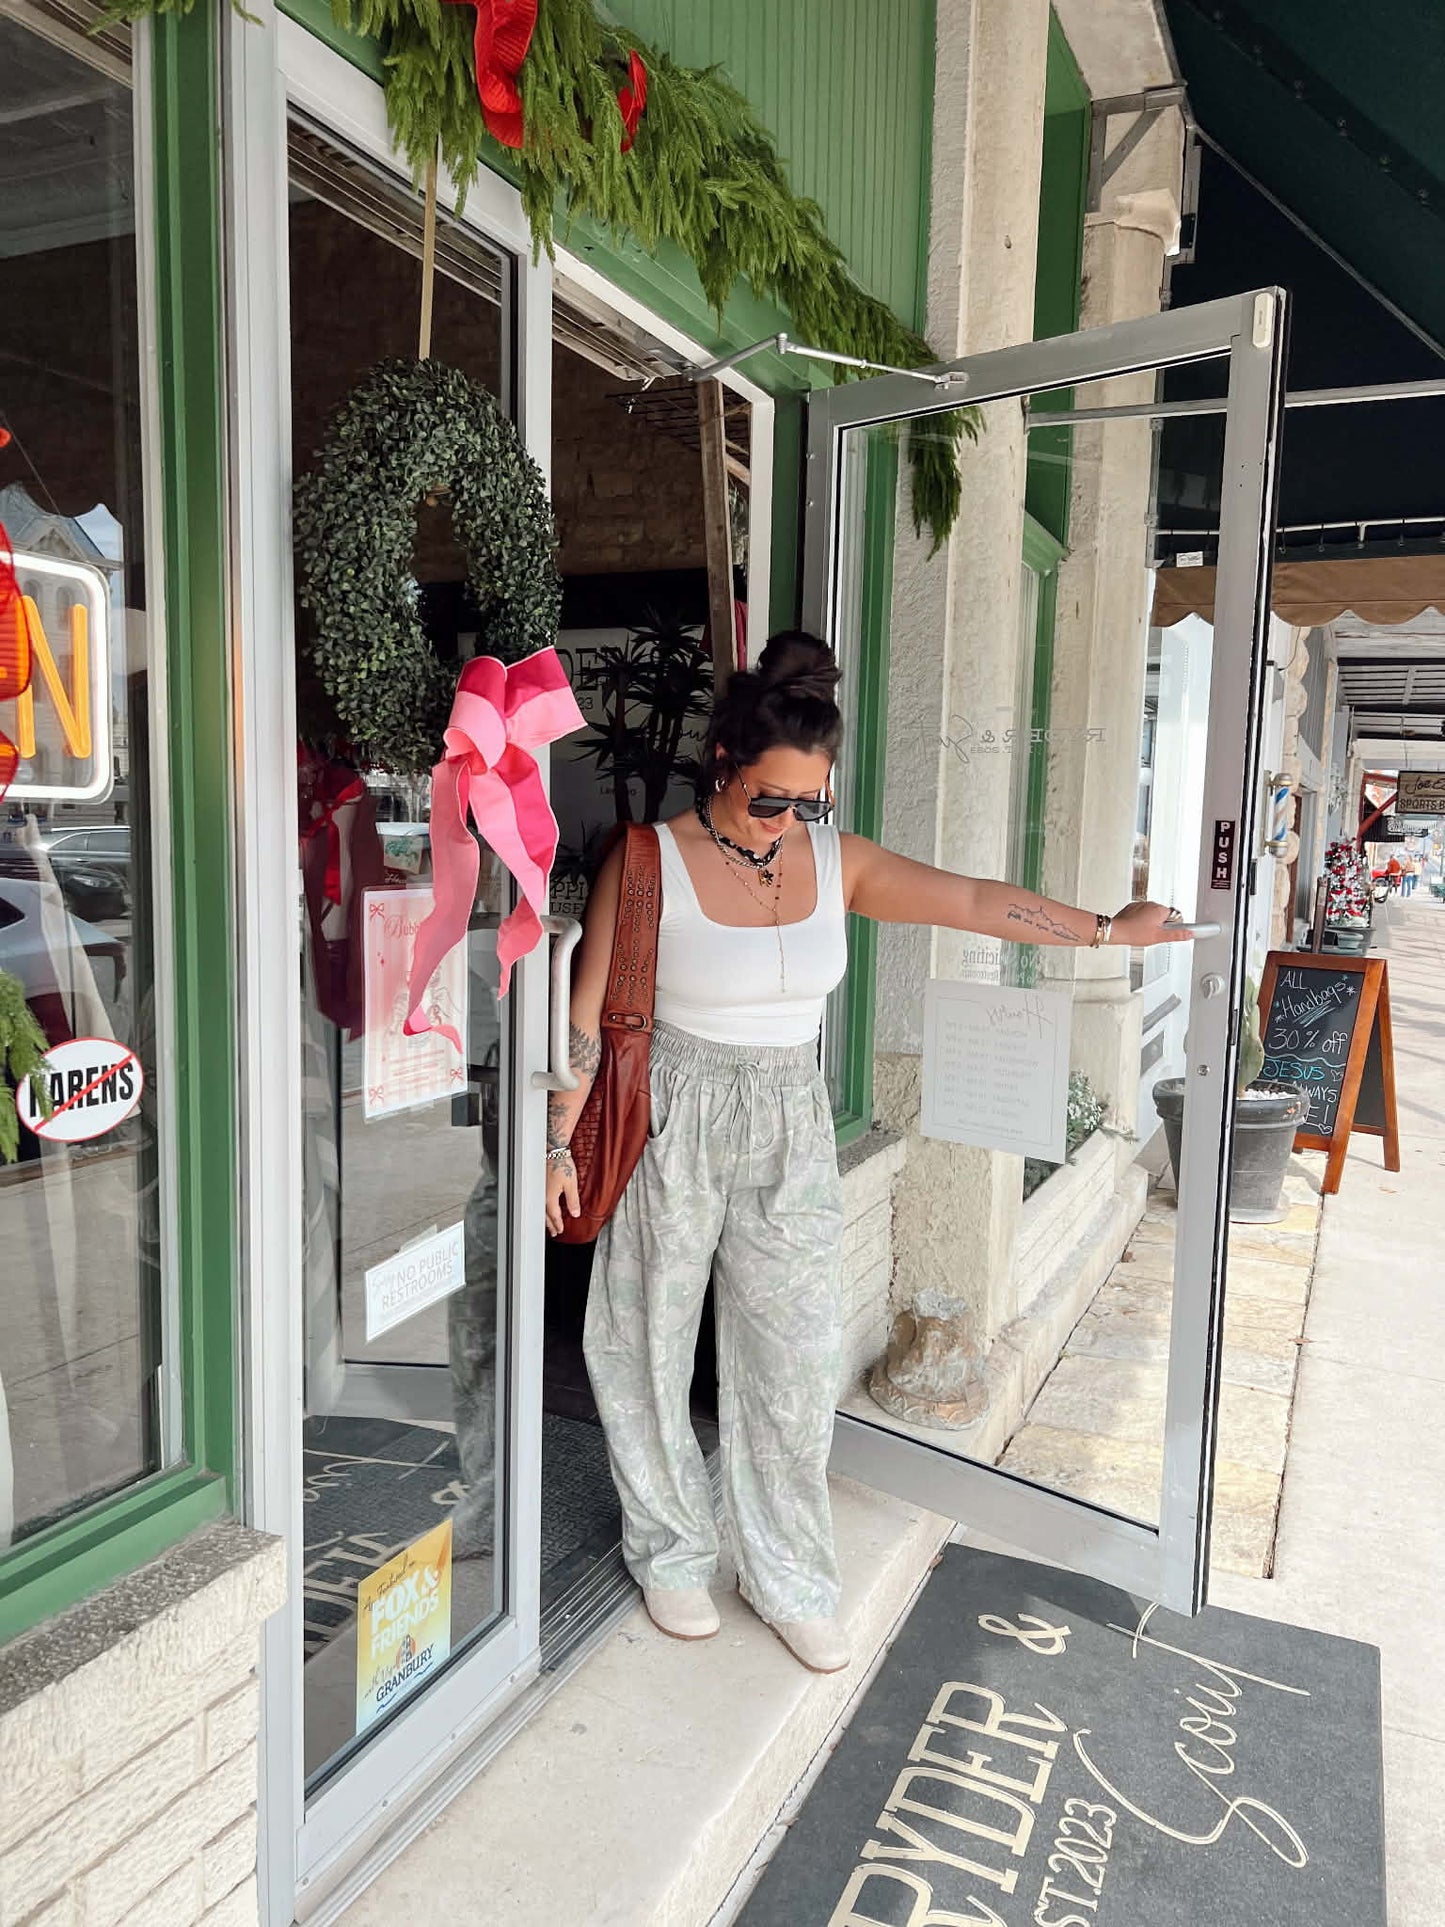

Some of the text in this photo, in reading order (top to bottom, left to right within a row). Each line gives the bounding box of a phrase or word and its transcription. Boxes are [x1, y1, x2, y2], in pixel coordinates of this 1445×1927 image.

[1400, 798, 1437, 810] SPORTS
[1405, 775, 1431, 795] Joe
[1216, 821, 1231, 879] PUSH
[1280, 970, 1309, 990] ALL
[1281, 981, 1346, 1019] Handbags
[1322, 1031, 1347, 1055] off
[1263, 1058, 1325, 1081] JESUS
[382, 1259, 453, 1310] RESTROOMS
[397, 1264, 416, 1289] NO
[419, 1241, 459, 1272] PUBLIC
[371, 1569, 421, 1634] FOX
[371, 1594, 439, 1662] FRIENDS
[977, 1612, 1072, 1656] &
[376, 1643, 434, 1702] GRANBURY
[1033, 1798, 1118, 1927] ST.2023
